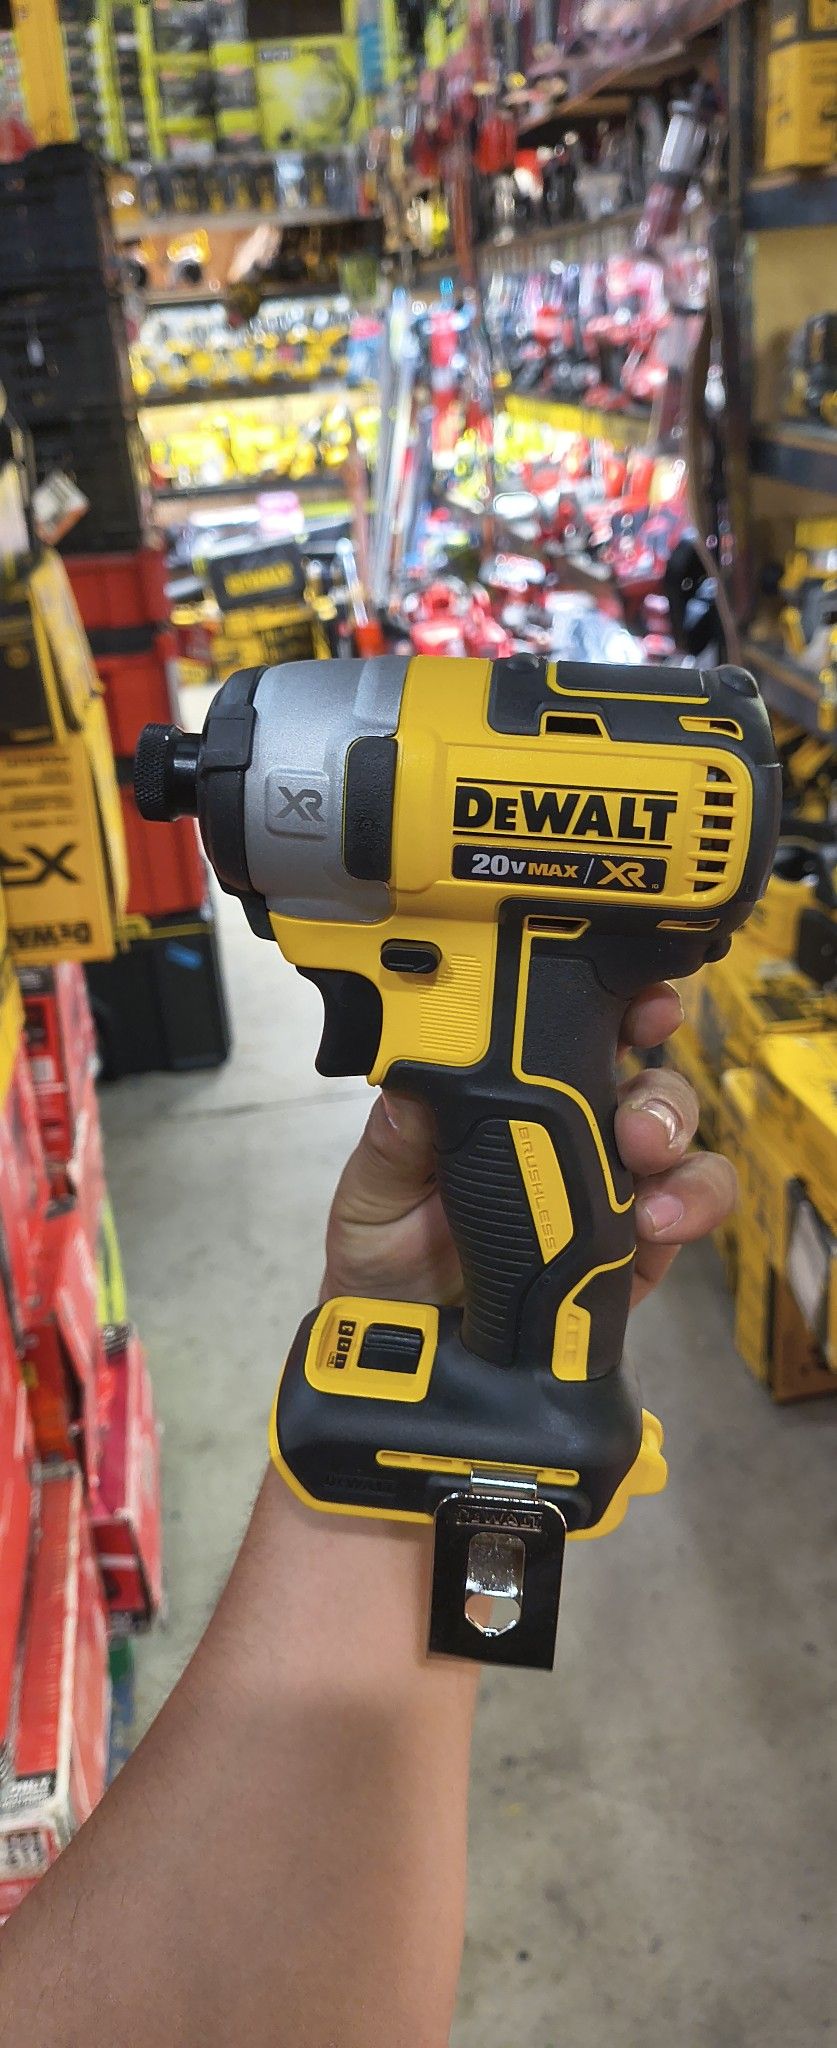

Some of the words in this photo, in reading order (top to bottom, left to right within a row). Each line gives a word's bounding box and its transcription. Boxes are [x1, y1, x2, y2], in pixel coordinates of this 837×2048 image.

[276, 786, 326, 822] XR
[453, 785, 678, 841] DEWALT
[597, 860, 646, 888] XR
[518, 1126, 556, 1249] BRUSHLESS
